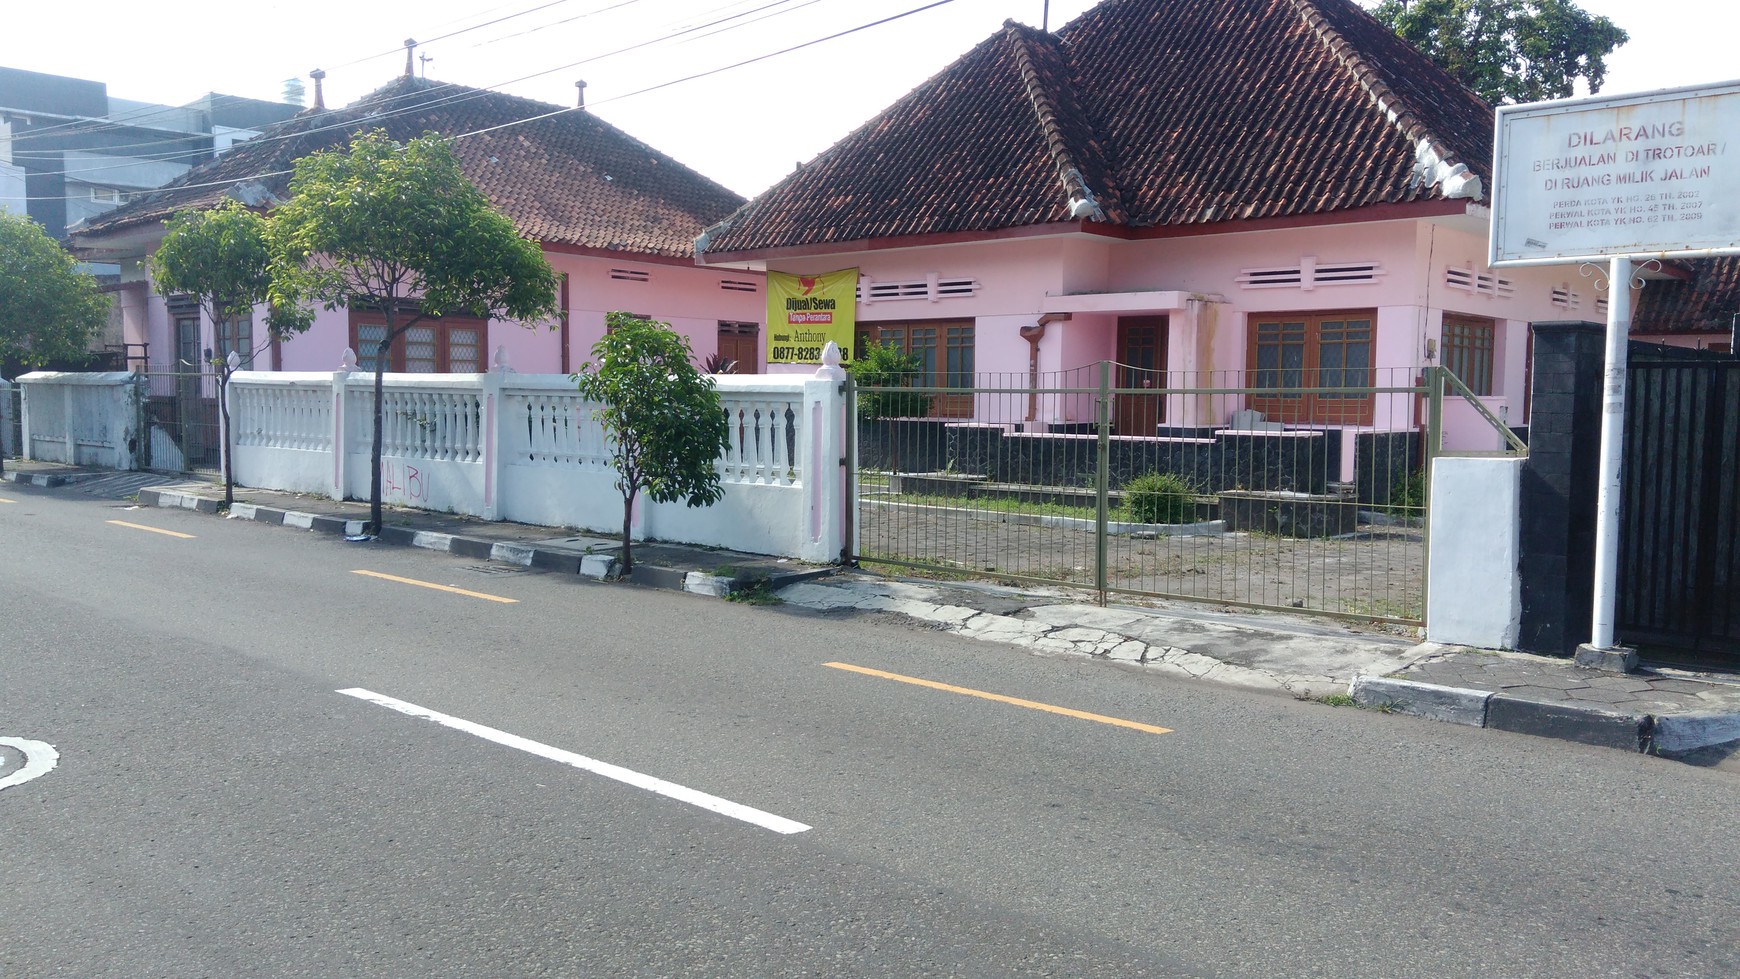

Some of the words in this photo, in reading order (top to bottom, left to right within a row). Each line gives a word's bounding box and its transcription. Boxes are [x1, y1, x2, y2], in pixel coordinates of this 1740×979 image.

[1567, 121, 1685, 148] DILARANG
[1533, 152, 1617, 172] BERJUALAN
[1625, 150, 1639, 163] DI
[1643, 143, 1717, 161] TROTOAR
[1544, 177, 1557, 191] DI
[1561, 173, 1612, 190] RUANG
[1615, 170, 1655, 186] MILIK
[1660, 165, 1711, 182] JALAN
[1549, 210, 1585, 219] PERWAL
[1587, 208, 1612, 216] KOTA
[1662, 203, 1678, 211] TH.
[1680, 201, 1703, 210] 2007
[1553, 200, 1582, 208] PERDA
[1584, 198, 1608, 206] KOTA
[1611, 196, 1623, 204] YK
[1549, 220, 1585, 230] PERWAL
[1587, 218, 1611, 227] KOTA
[1613, 217, 1626, 225] YK
[1680, 212, 1703, 220] 2009
[786, 297, 836, 311] Dijual/Sewa
[789, 312, 806, 323] Tanpa
[806, 312, 831, 322] Perantara
[794, 329, 826, 345] Anthony
